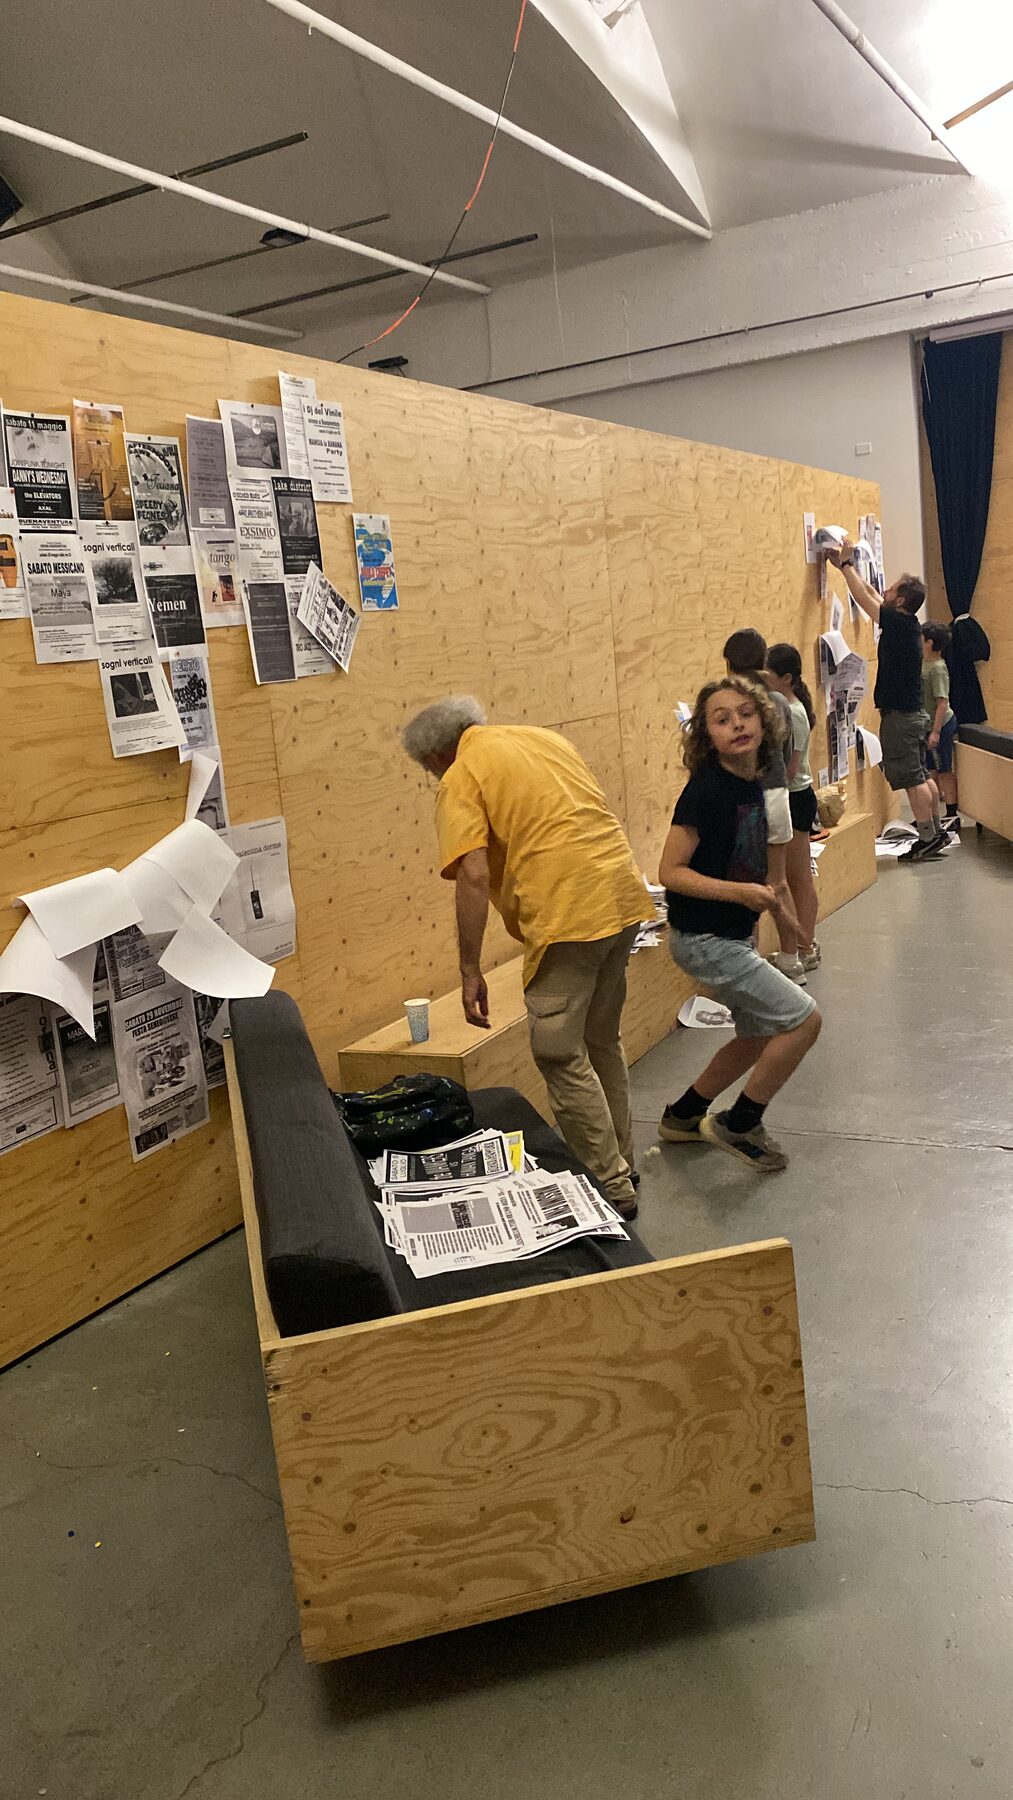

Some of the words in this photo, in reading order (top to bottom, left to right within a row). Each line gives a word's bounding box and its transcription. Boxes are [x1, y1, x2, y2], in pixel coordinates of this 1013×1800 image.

[6, 418, 27, 427] sabato
[28, 420, 35, 429] 11
[37, 421, 63, 432] maggio
[326, 448, 342, 456] Party
[12, 470, 36, 483] DANNY'S
[36, 471, 67, 485] WEDNESDAY
[274, 480, 288, 490] Lake
[290, 480, 312, 492] district
[34, 492, 62, 500] ELEVATORS
[136, 500, 163, 510] SPEEDY
[240, 526, 276, 538] EXSIMIO
[84, 543, 104, 554] sogni
[106, 542, 136, 552] verticali
[210, 552, 236, 566] tango
[28, 562, 52, 574] SABATO
[53, 562, 85, 574] MESSICANO
[51, 587, 72, 598] Maya
[148, 598, 187, 612] Yemen
[102, 659, 122, 670] sogni
[124, 656, 154, 668] verticali
[132, 1024, 148, 1038] FESTA
